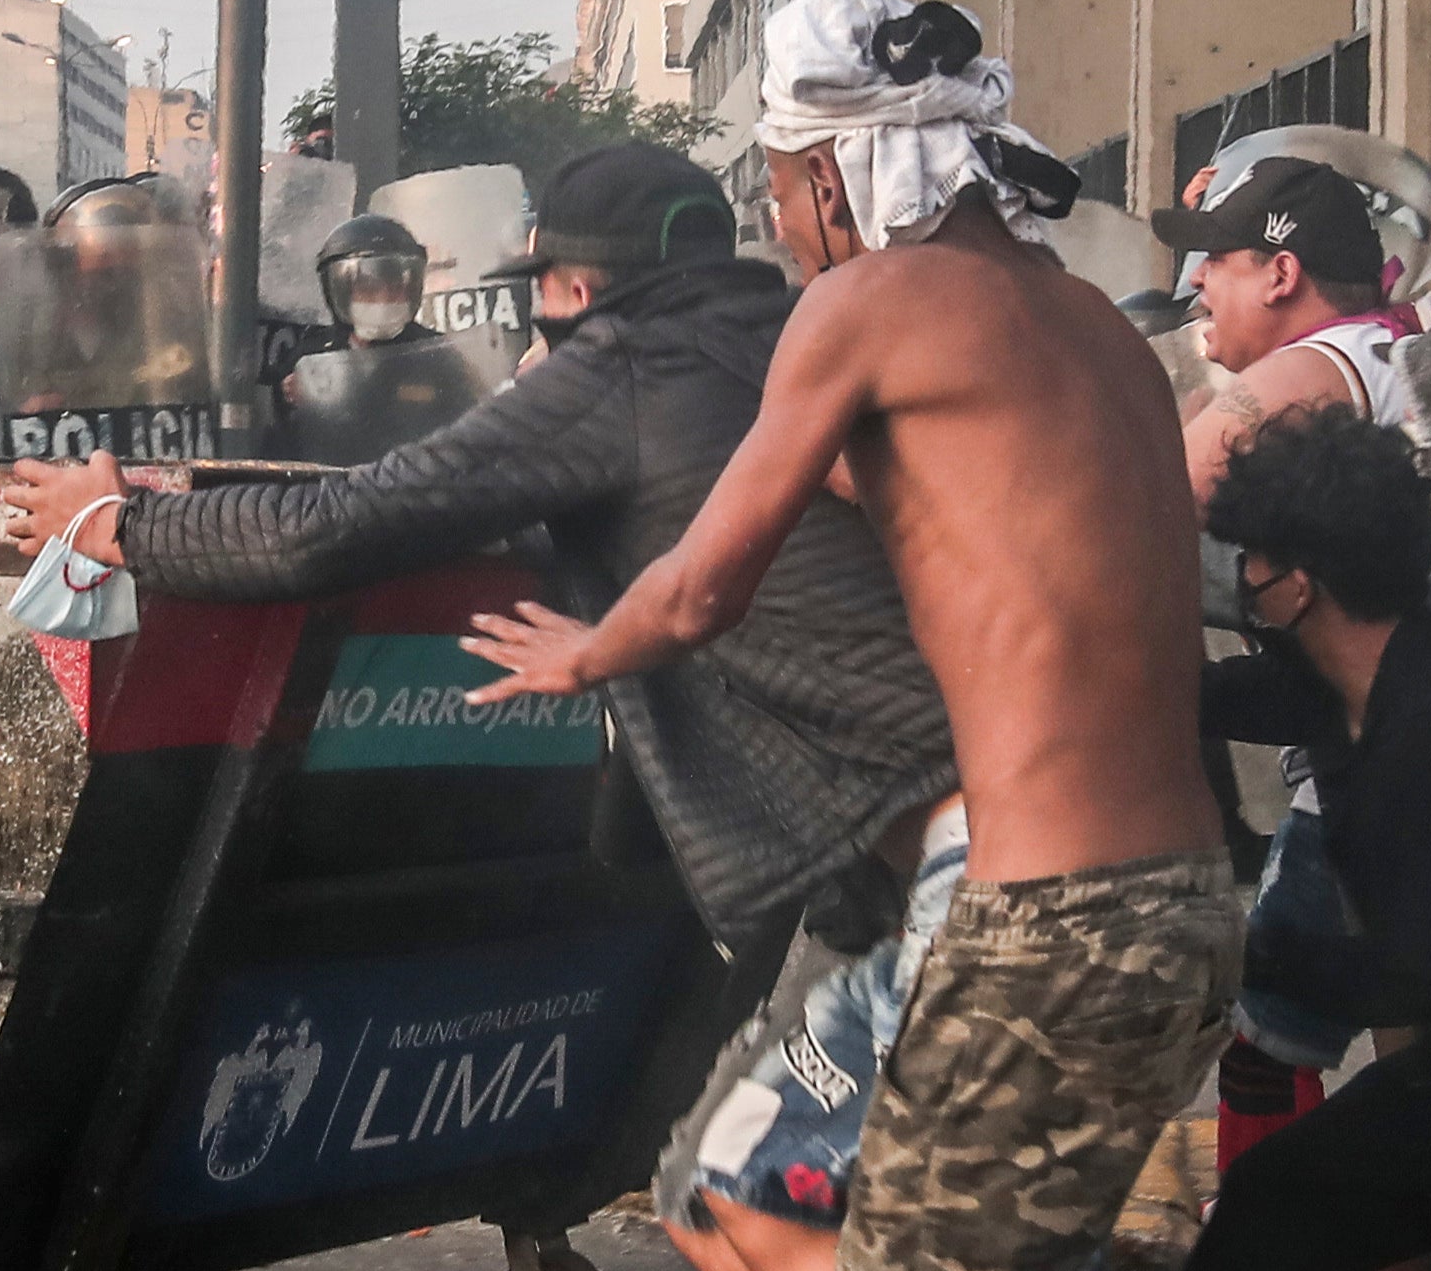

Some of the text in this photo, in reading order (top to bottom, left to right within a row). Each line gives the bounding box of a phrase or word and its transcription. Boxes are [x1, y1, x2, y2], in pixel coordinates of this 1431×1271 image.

[313, 685, 378, 730] NO
[389, 988, 604, 1049] MUNICIPALIDAD DE
[350, 1033, 567, 1151] LIMA
